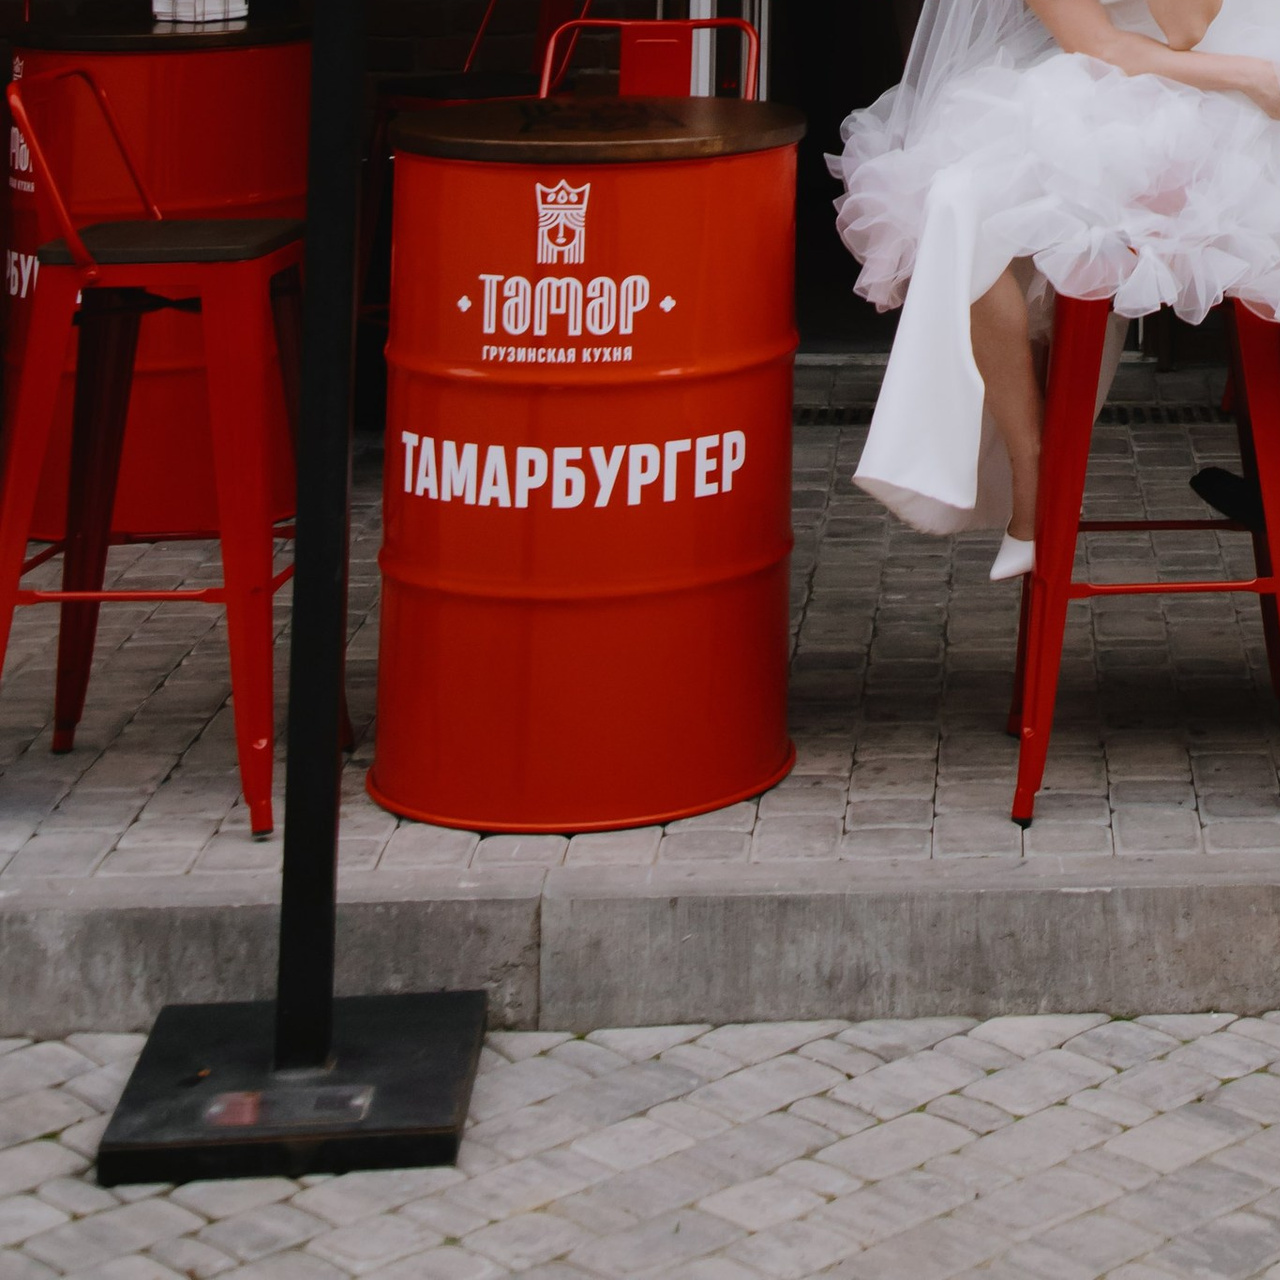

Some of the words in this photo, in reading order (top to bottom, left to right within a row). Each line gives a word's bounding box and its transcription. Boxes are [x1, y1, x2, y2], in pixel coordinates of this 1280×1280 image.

[482, 345, 576, 363] ГРУЗИНСКАЯ
[581, 345, 633, 363] КУХНЯ
[401, 430, 747, 509] ТАМАРБУРГЕР
